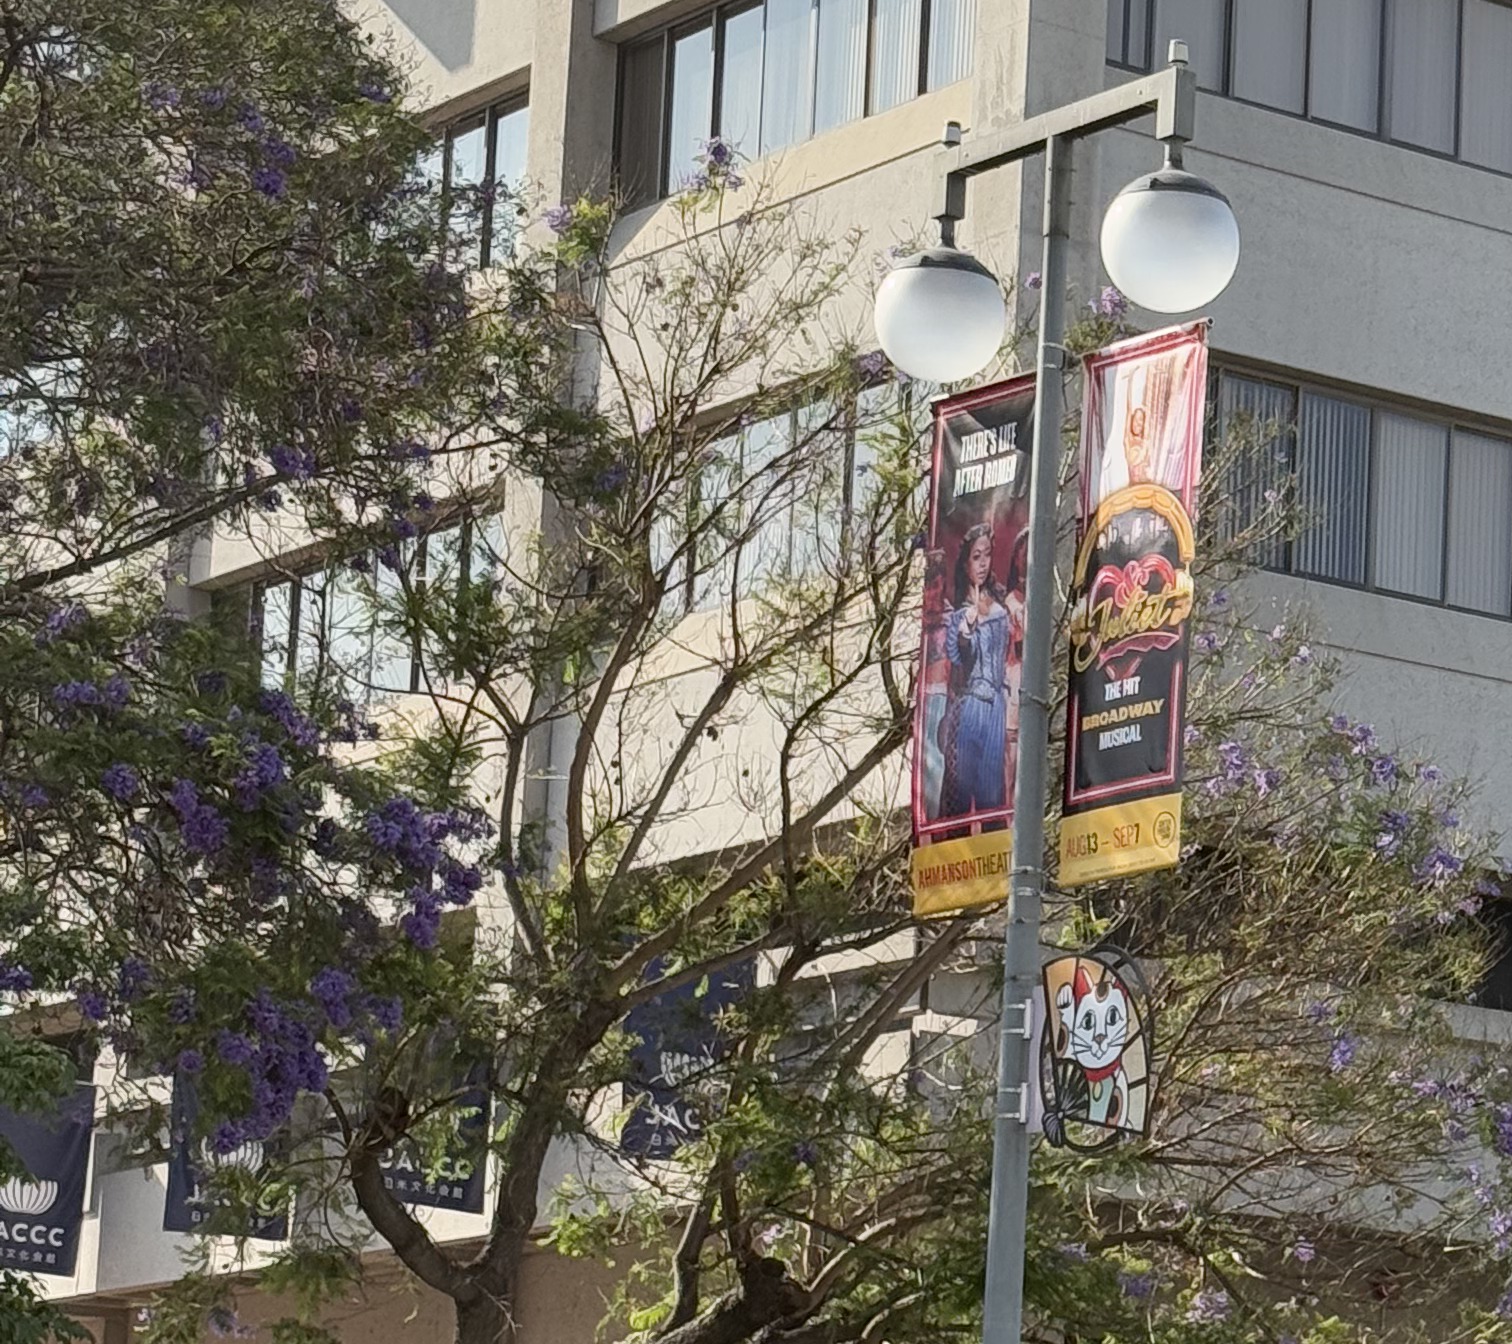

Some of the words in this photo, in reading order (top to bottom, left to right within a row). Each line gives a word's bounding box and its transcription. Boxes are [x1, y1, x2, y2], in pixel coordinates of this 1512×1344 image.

[960, 427, 998, 464] THERE'S
[998, 422, 1018, 454] LIFE
[953, 463, 984, 497] AFTER
[983, 454, 1018, 490] ROMEO
[1074, 582, 1191, 673] Juliet
[1104, 681, 1122, 702] THE
[1122, 676, 1141, 696] HIT
[1082, 698, 1166, 731] BROADWAY
[1098, 723, 1143, 752] MUSICAL
[918, 850, 1013, 890] AHMANSONTHEAT
[0, 1220, 66, 1248] ACCC
